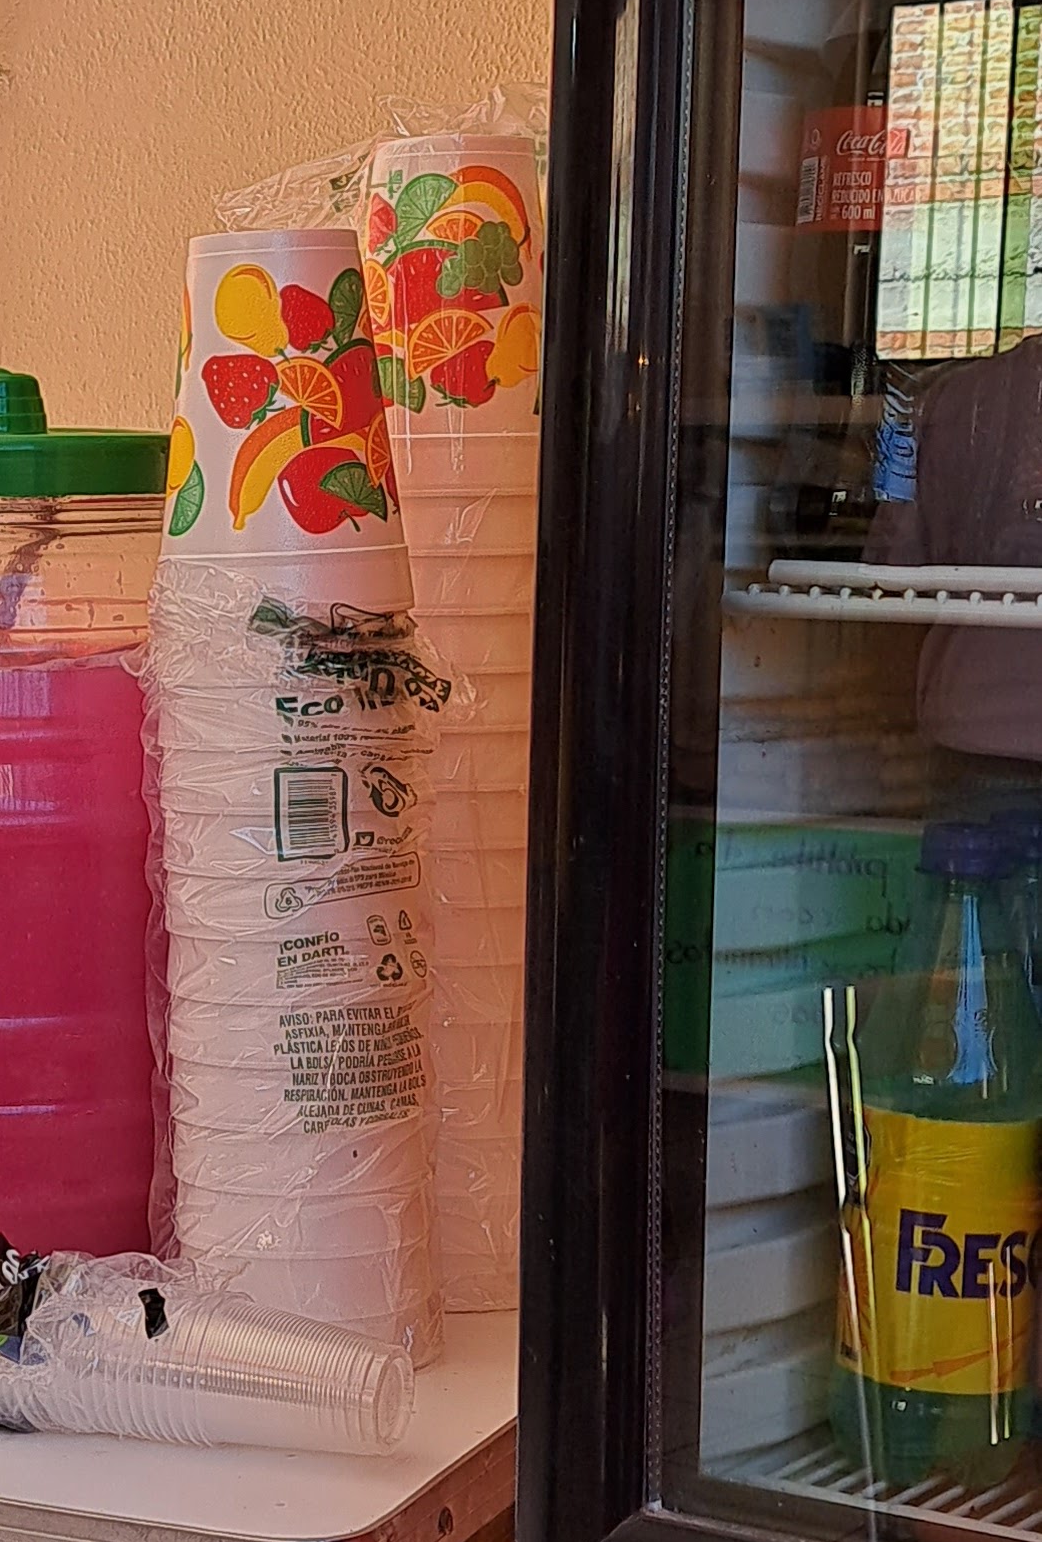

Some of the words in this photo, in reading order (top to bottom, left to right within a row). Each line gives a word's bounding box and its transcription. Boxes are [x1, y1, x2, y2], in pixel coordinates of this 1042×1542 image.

[832, 171, 872, 187] REFRESCO
[831, 188, 871, 204] REDUCIDO
[841, 206, 861, 220] 600
[862, 206, 876, 220] ml
[279, 931, 340, 954] ¡CONFÍO
[277, 953, 297, 968] EN
[279, 1012, 314, 1028] AVISO:
[316, 1009, 345, 1024] PARA
[347, 1007, 382, 1020] EVITAR
[384, 1006, 395, 1019] EL
[285, 1027, 330, 1040] ASFIXIA,
[273, 1039, 323, 1055] PLÁSTICA
[358, 1039, 371, 1052] DE
[290, 1056, 303, 1070] LA
[338, 1053, 375, 1069] PODRÍA
[292, 1072, 318, 1085] NARIZ
[330, 1071, 356, 1085] BOCA
[283, 1085, 348, 1102] RESPIRACIÓN.
[350, 1084, 398, 1100] MANTENGA
[296, 1104, 340, 1118] ALEJADA
[342, 1104, 355, 1116] DE
